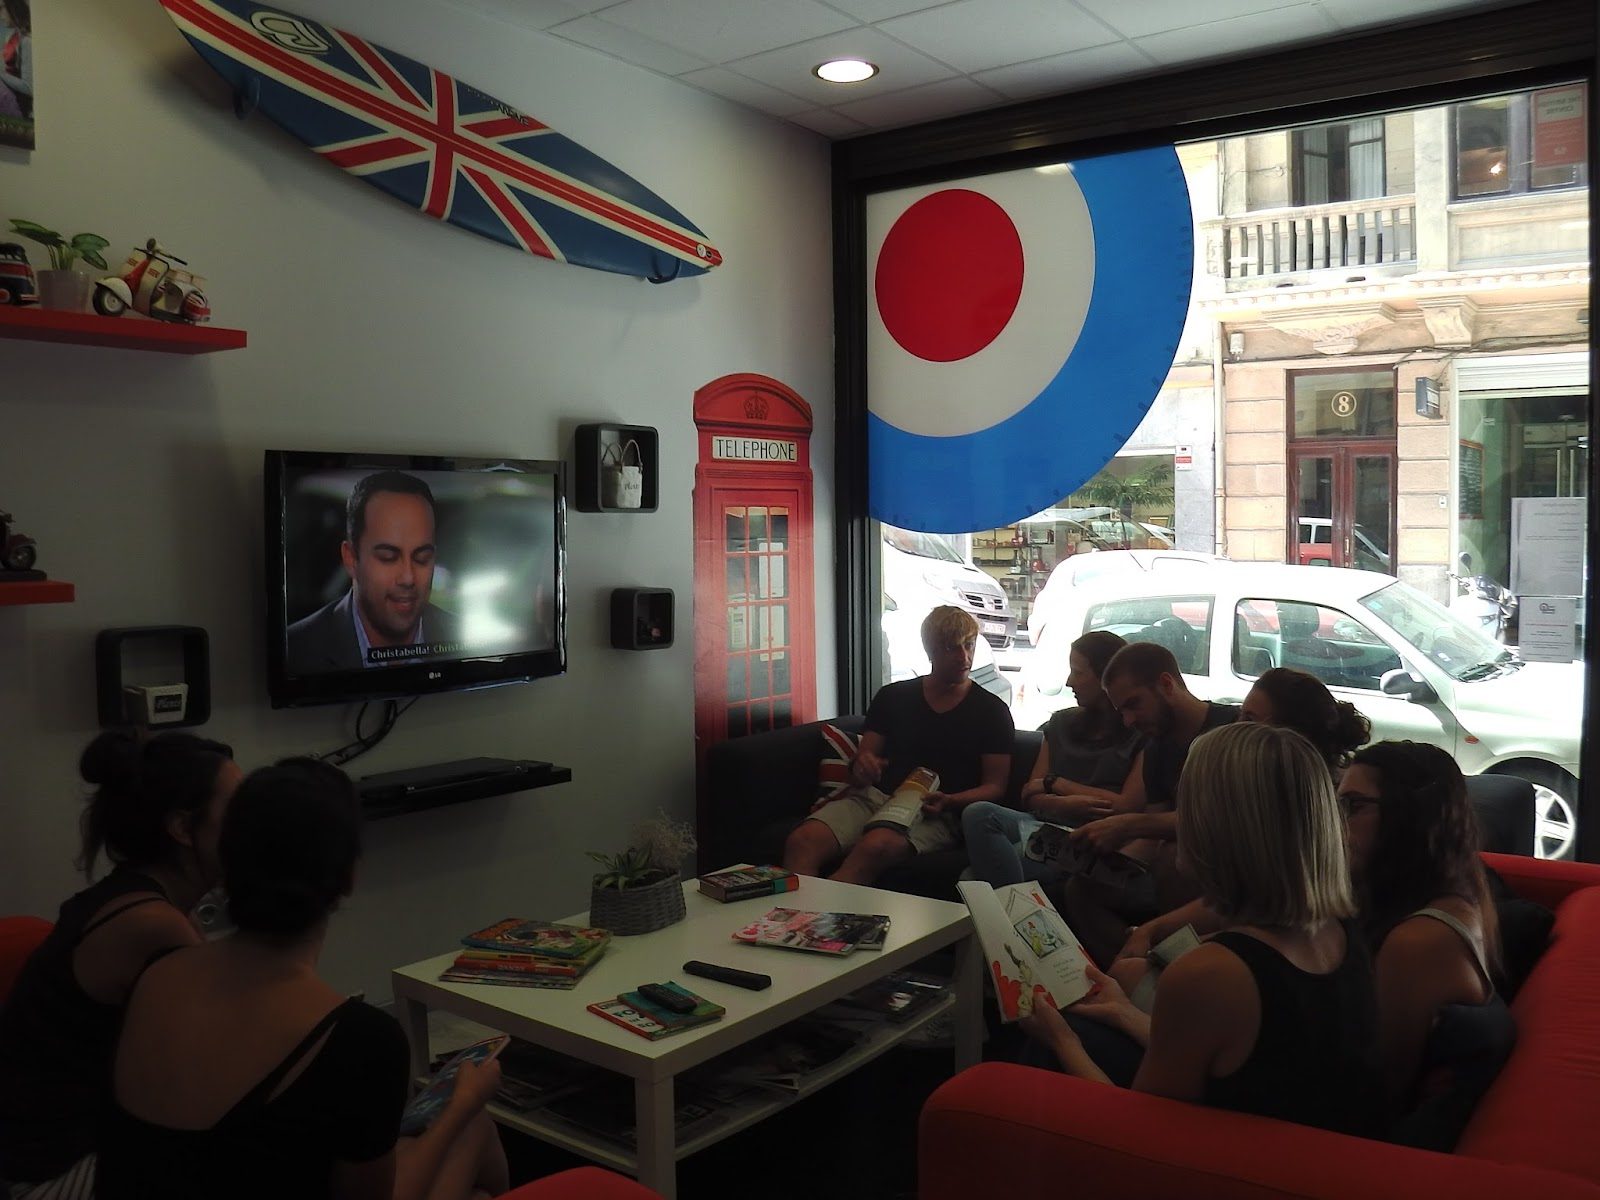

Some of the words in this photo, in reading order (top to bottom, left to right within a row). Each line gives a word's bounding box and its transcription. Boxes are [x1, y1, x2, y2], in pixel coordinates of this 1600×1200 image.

[1338, 395, 1350, 413] 8
[716, 439, 795, 460] TELEPHONE
[371, 645, 430, 660] Christabella!
